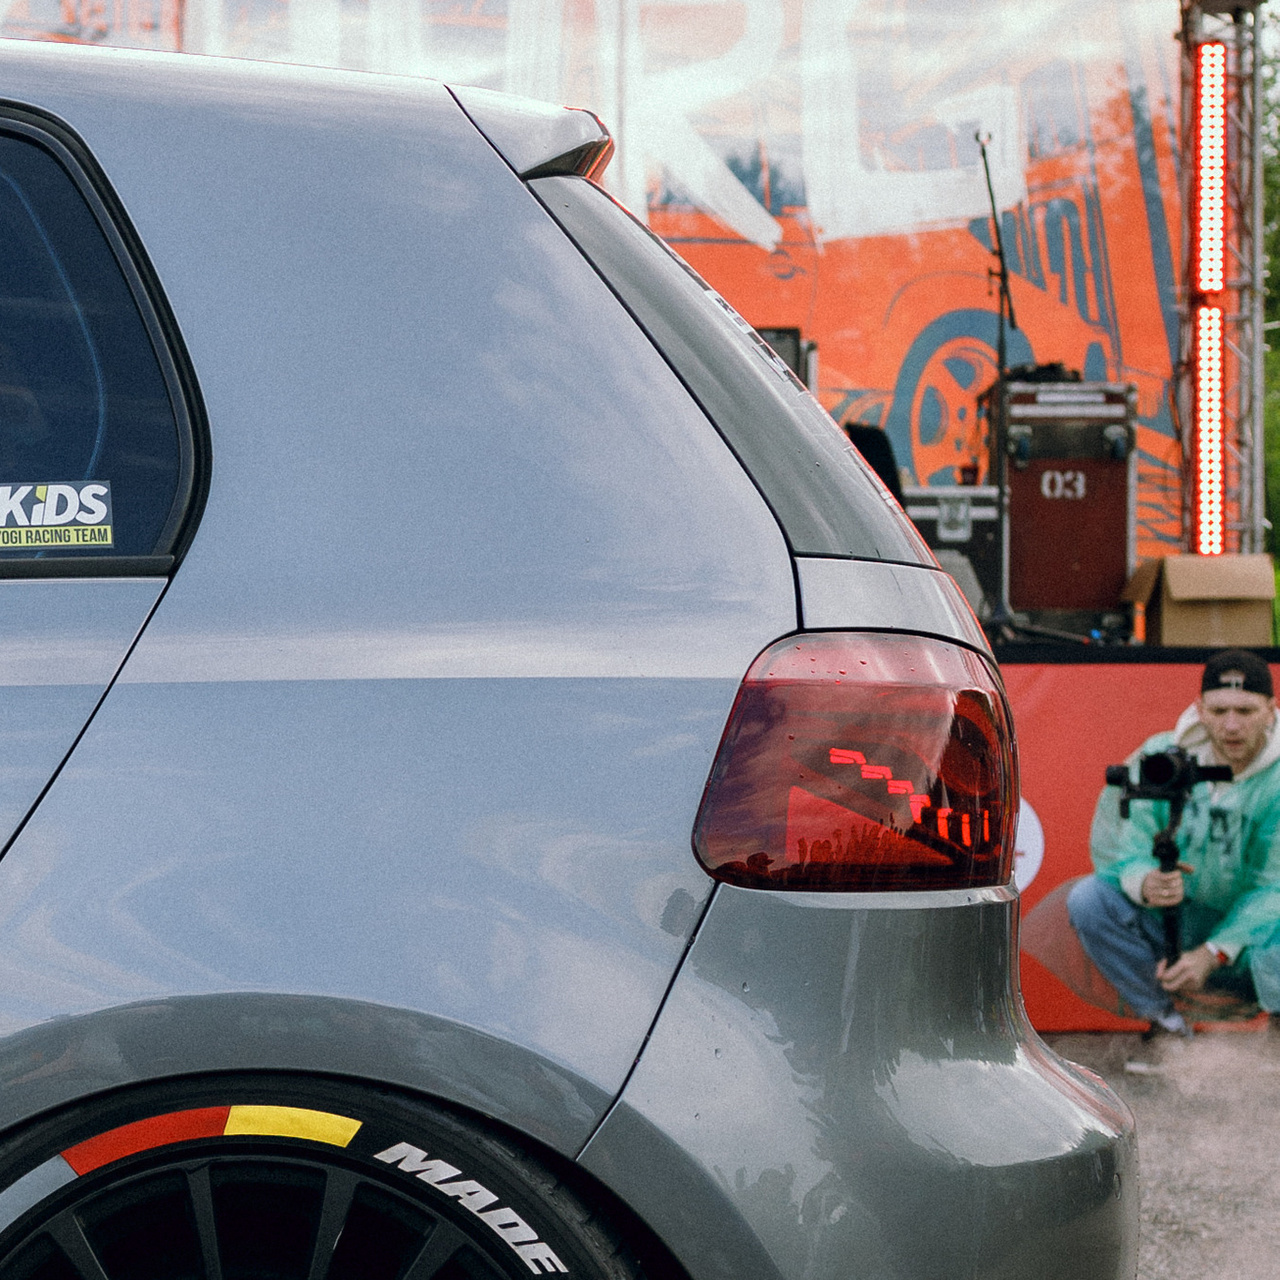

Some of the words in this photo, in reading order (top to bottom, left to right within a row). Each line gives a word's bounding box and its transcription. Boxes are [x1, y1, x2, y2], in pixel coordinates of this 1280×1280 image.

[1040, 470, 1086, 499] 03
[25, 528, 71, 544] RACING
[73, 527, 108, 543] TEAM
[373, 1142, 569, 1275] MADE
